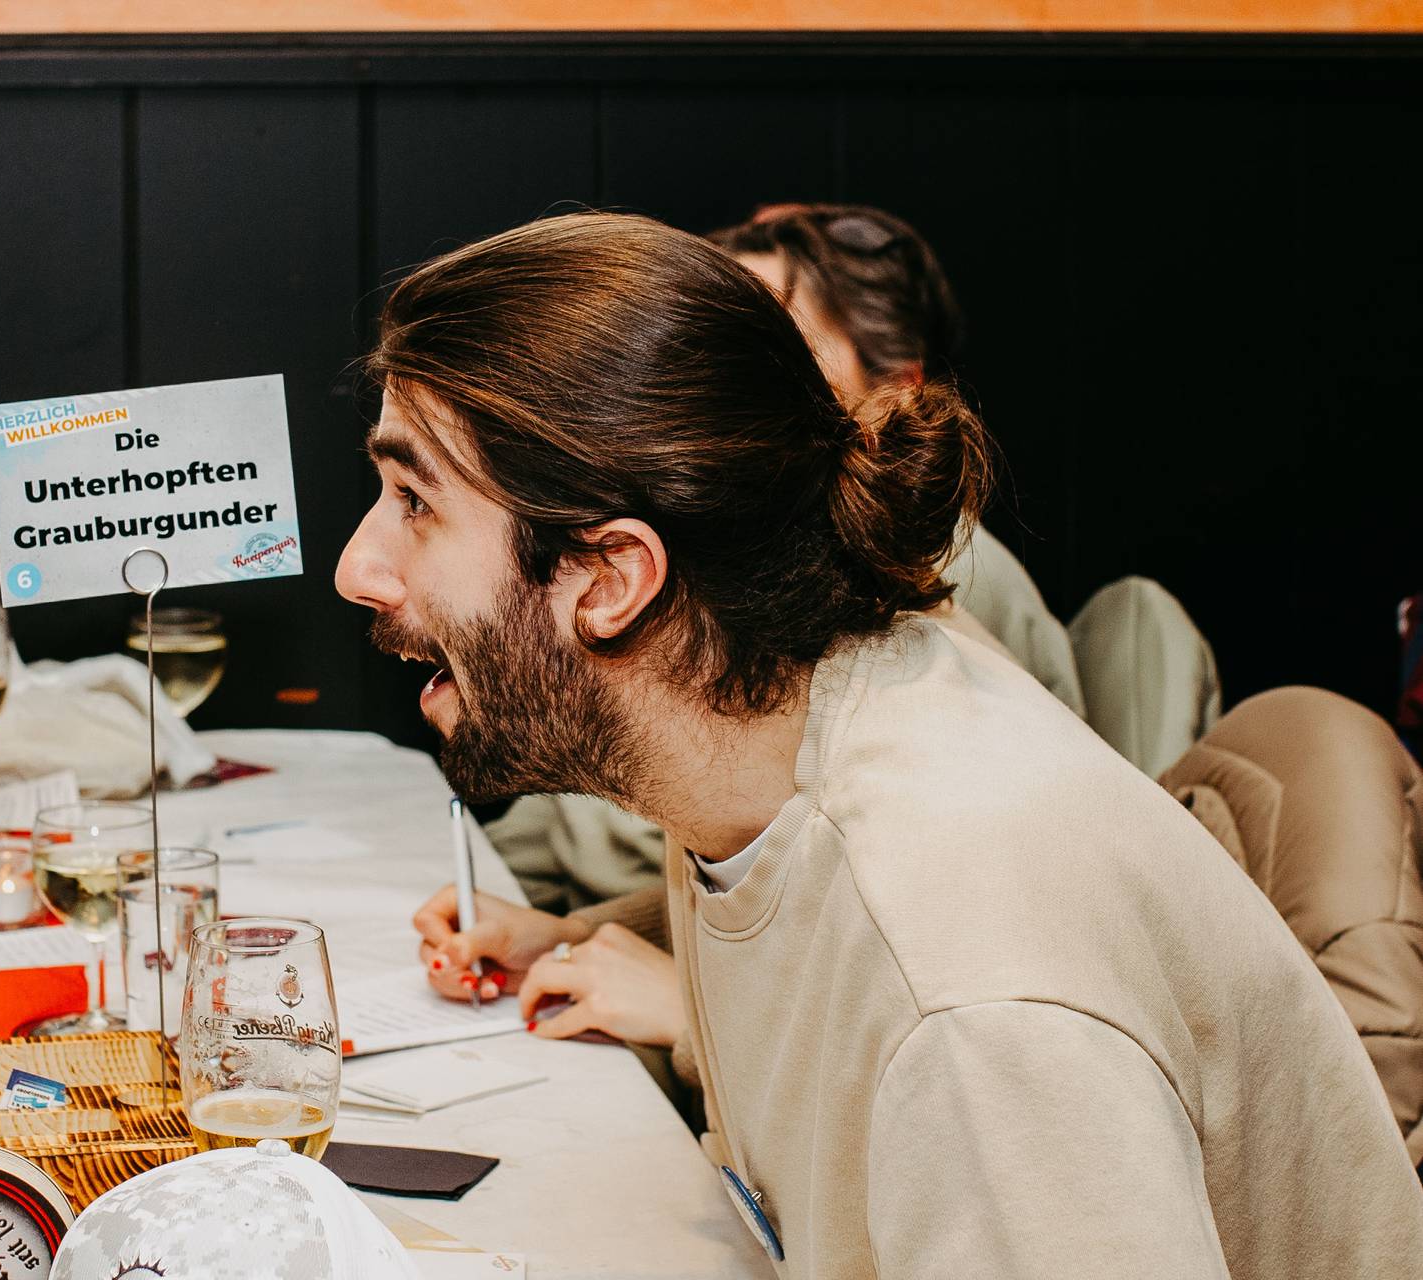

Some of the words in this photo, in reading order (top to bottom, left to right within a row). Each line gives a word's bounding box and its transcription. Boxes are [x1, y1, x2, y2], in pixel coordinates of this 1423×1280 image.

[7, 407, 128, 443] WILLKOMMEN
[115, 429, 160, 451] Die
[25, 460, 258, 503] Unterhopften
[14, 501, 278, 549] Grauburgunder
[233, 536, 297, 568] Kneipenquiz
[16, 569, 33, 589] 6
[7, 1238, 40, 1270] seit
